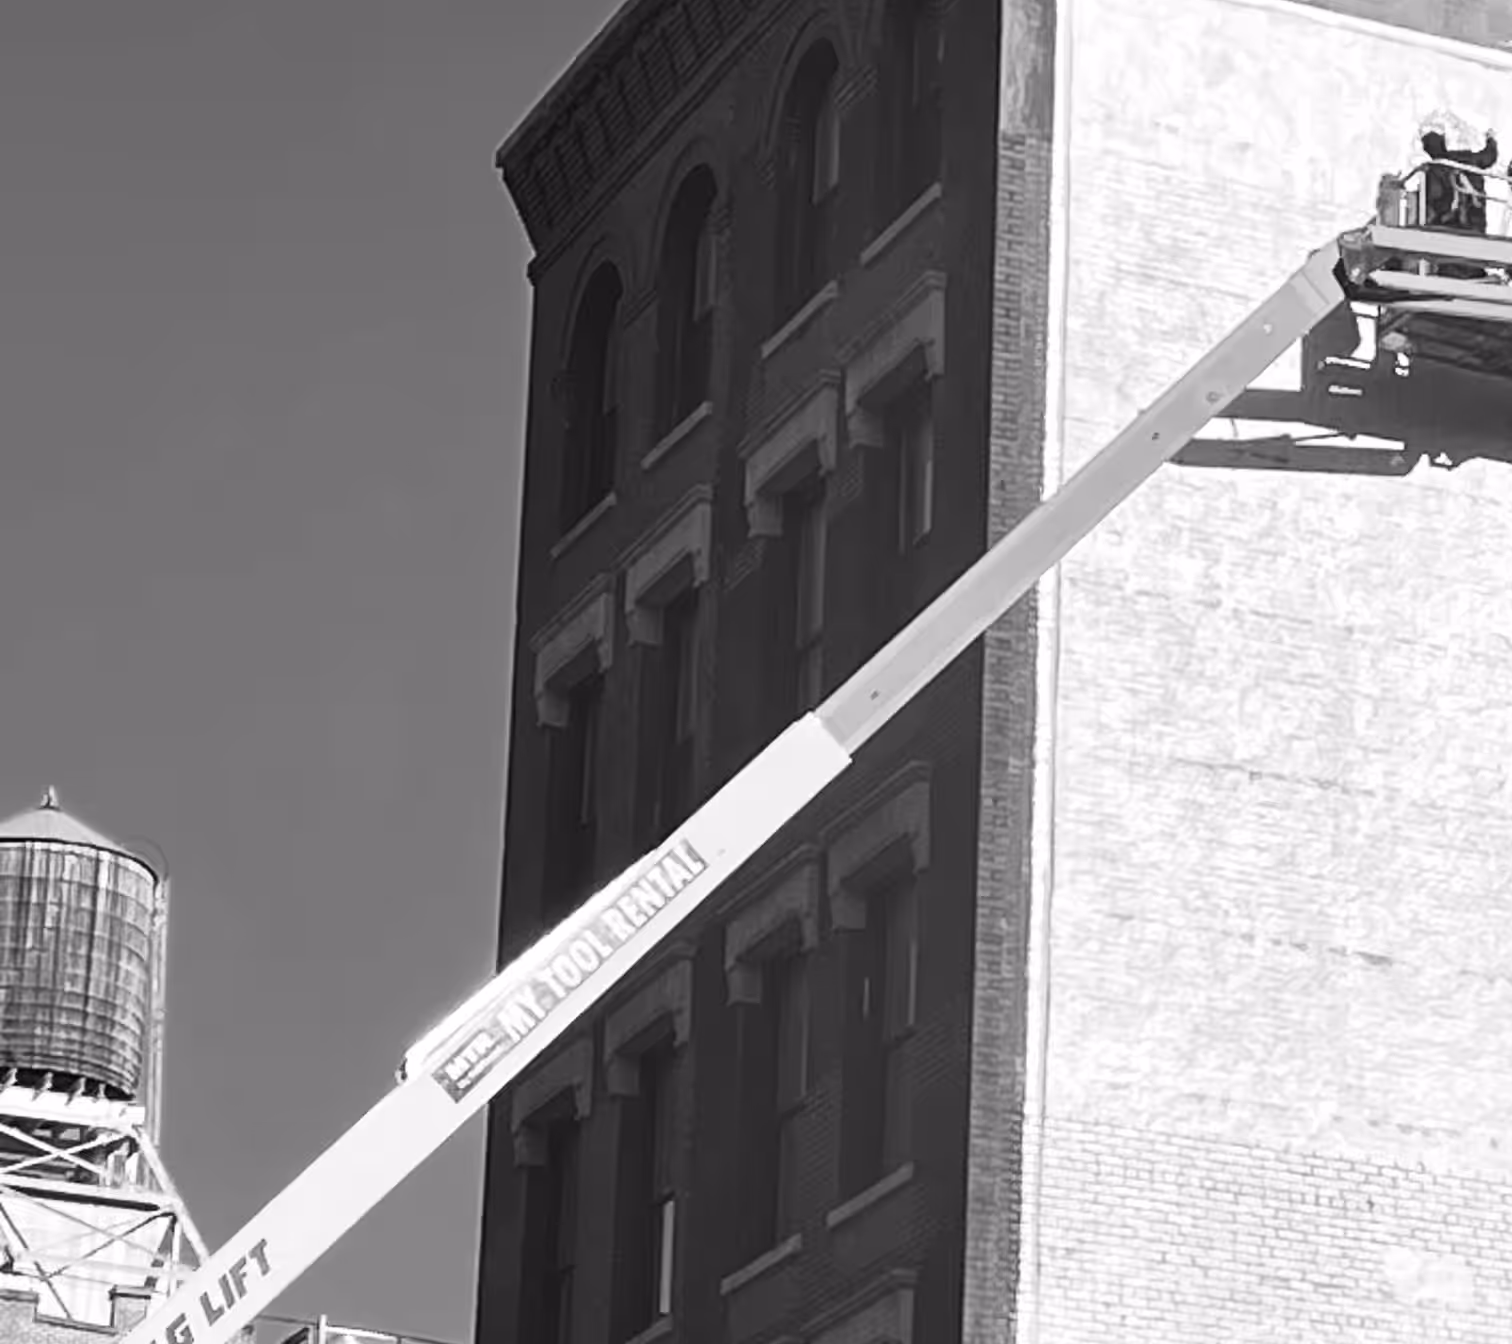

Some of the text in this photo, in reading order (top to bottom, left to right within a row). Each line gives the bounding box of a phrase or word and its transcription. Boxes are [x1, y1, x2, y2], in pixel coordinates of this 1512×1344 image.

[497, 982, 547, 1042] MY
[540, 929, 614, 1000] TOOL
[601, 843, 704, 942] RENTAL
[200, 1238, 270, 1326] LIFT
